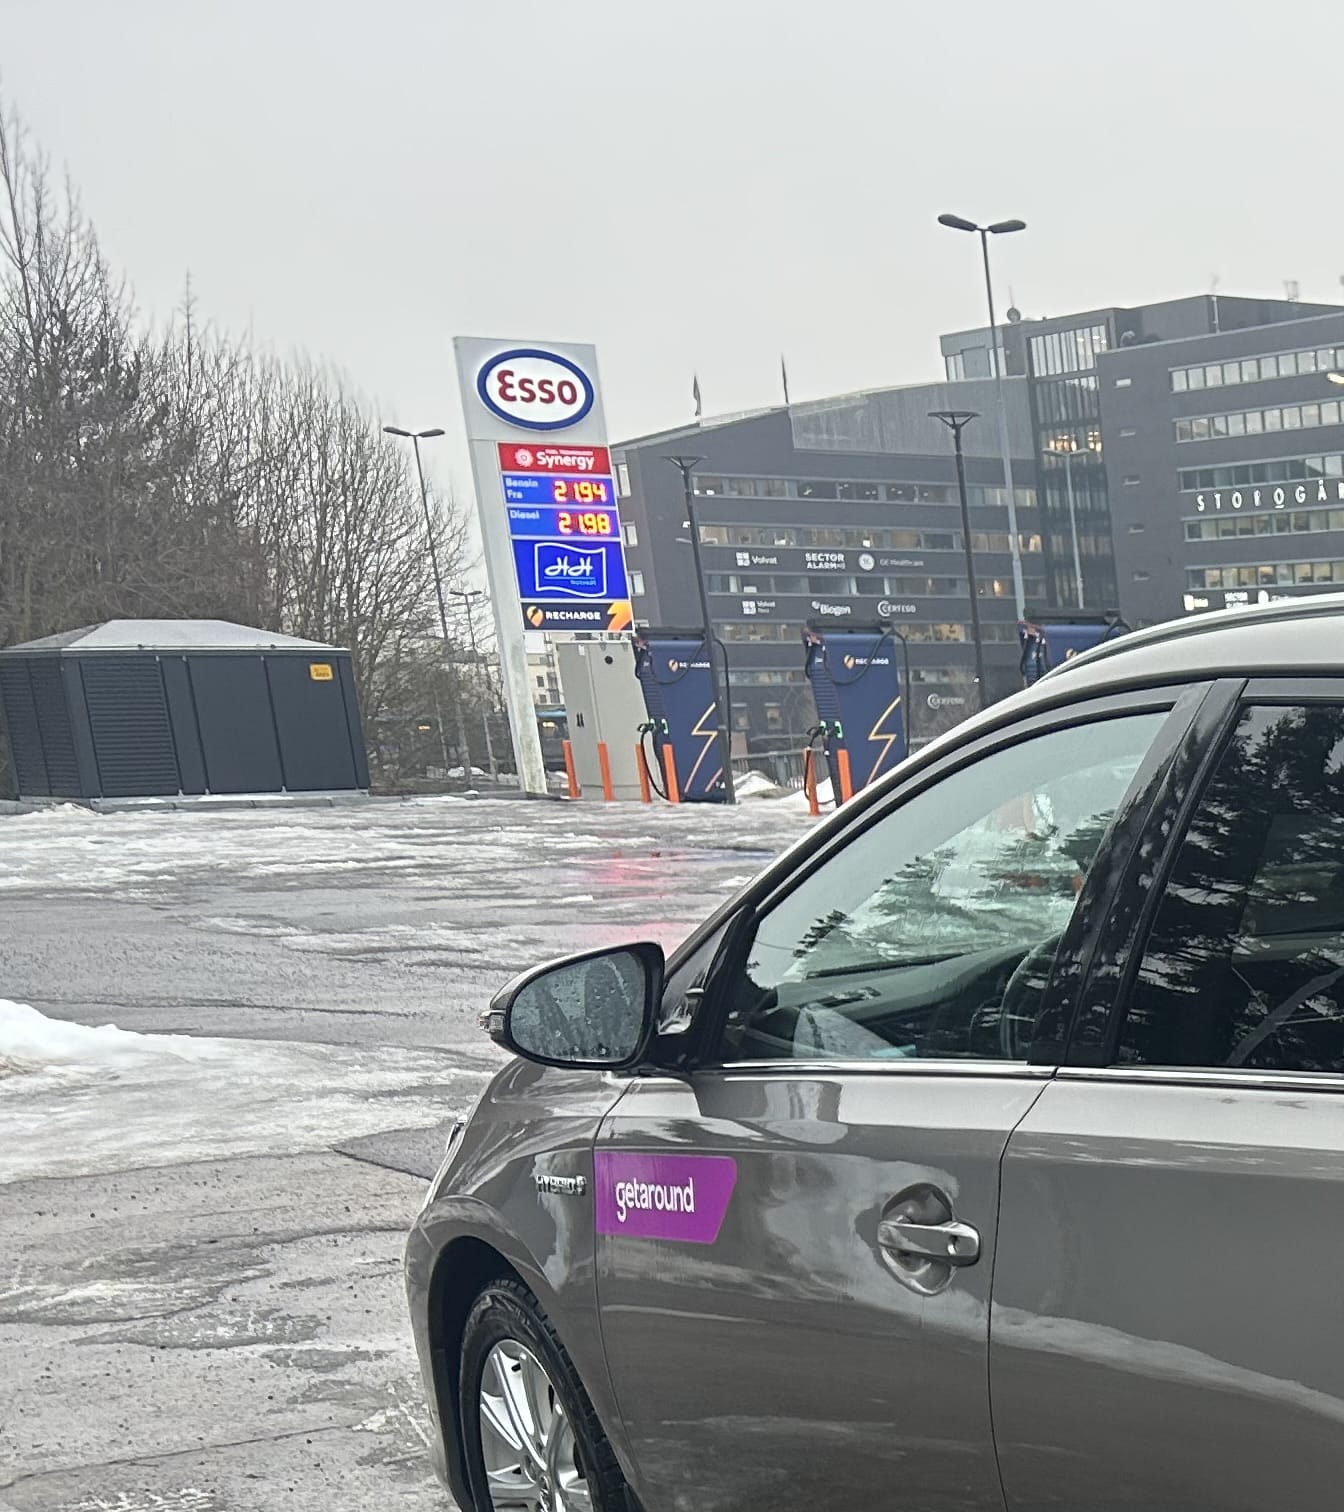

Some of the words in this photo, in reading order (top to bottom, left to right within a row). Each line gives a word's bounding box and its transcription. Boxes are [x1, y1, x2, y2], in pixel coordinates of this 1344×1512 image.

[536, 451, 595, 471] Synergy
[505, 478, 538, 488] Bensin
[510, 510, 540, 520] Diesel
[751, 556, 778, 565] Volvat
[805, 552, 845, 562] SECTOR
[545, 611, 601, 621] RECHARGE
[615, 1177, 695, 1222] getaround
